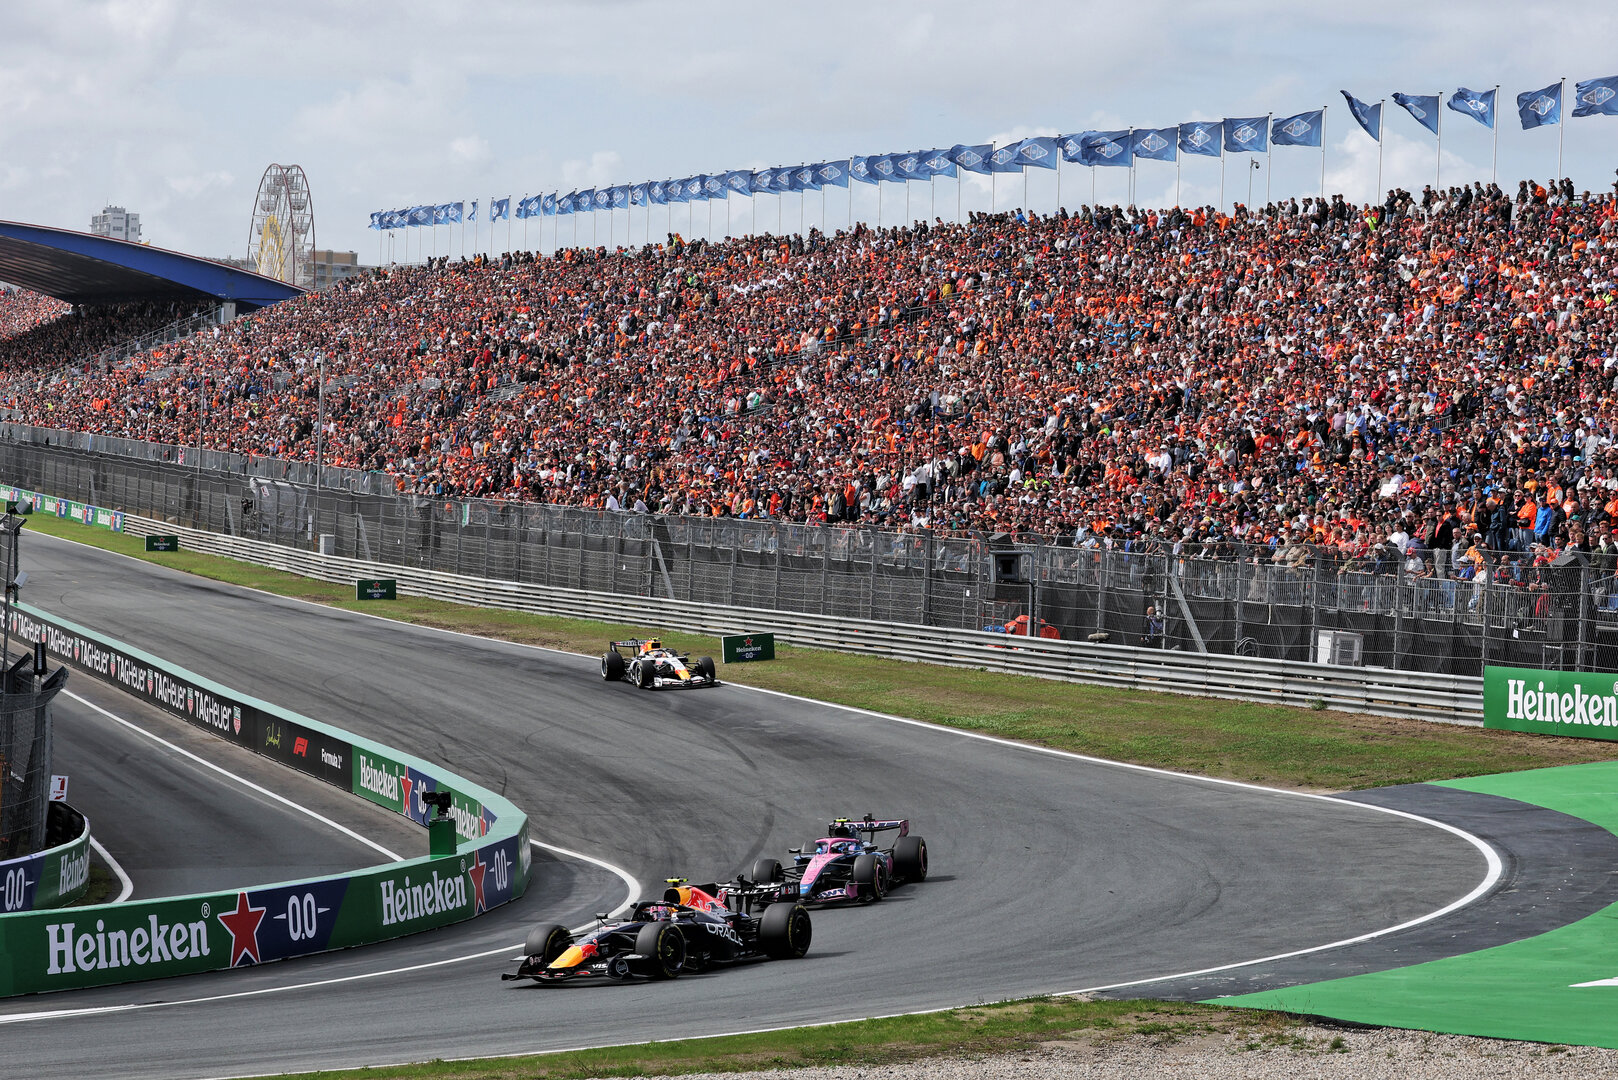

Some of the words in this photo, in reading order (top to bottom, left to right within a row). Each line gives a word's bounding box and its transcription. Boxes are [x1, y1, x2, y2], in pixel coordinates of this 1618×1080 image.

[1507, 679, 1618, 727] Heineken
[360, 754, 399, 801] Heineken
[5, 867, 25, 911] 0.0
[380, 870, 467, 926] Heineken
[46, 914, 210, 975] Heineken
[288, 892, 317, 941] 0.0
